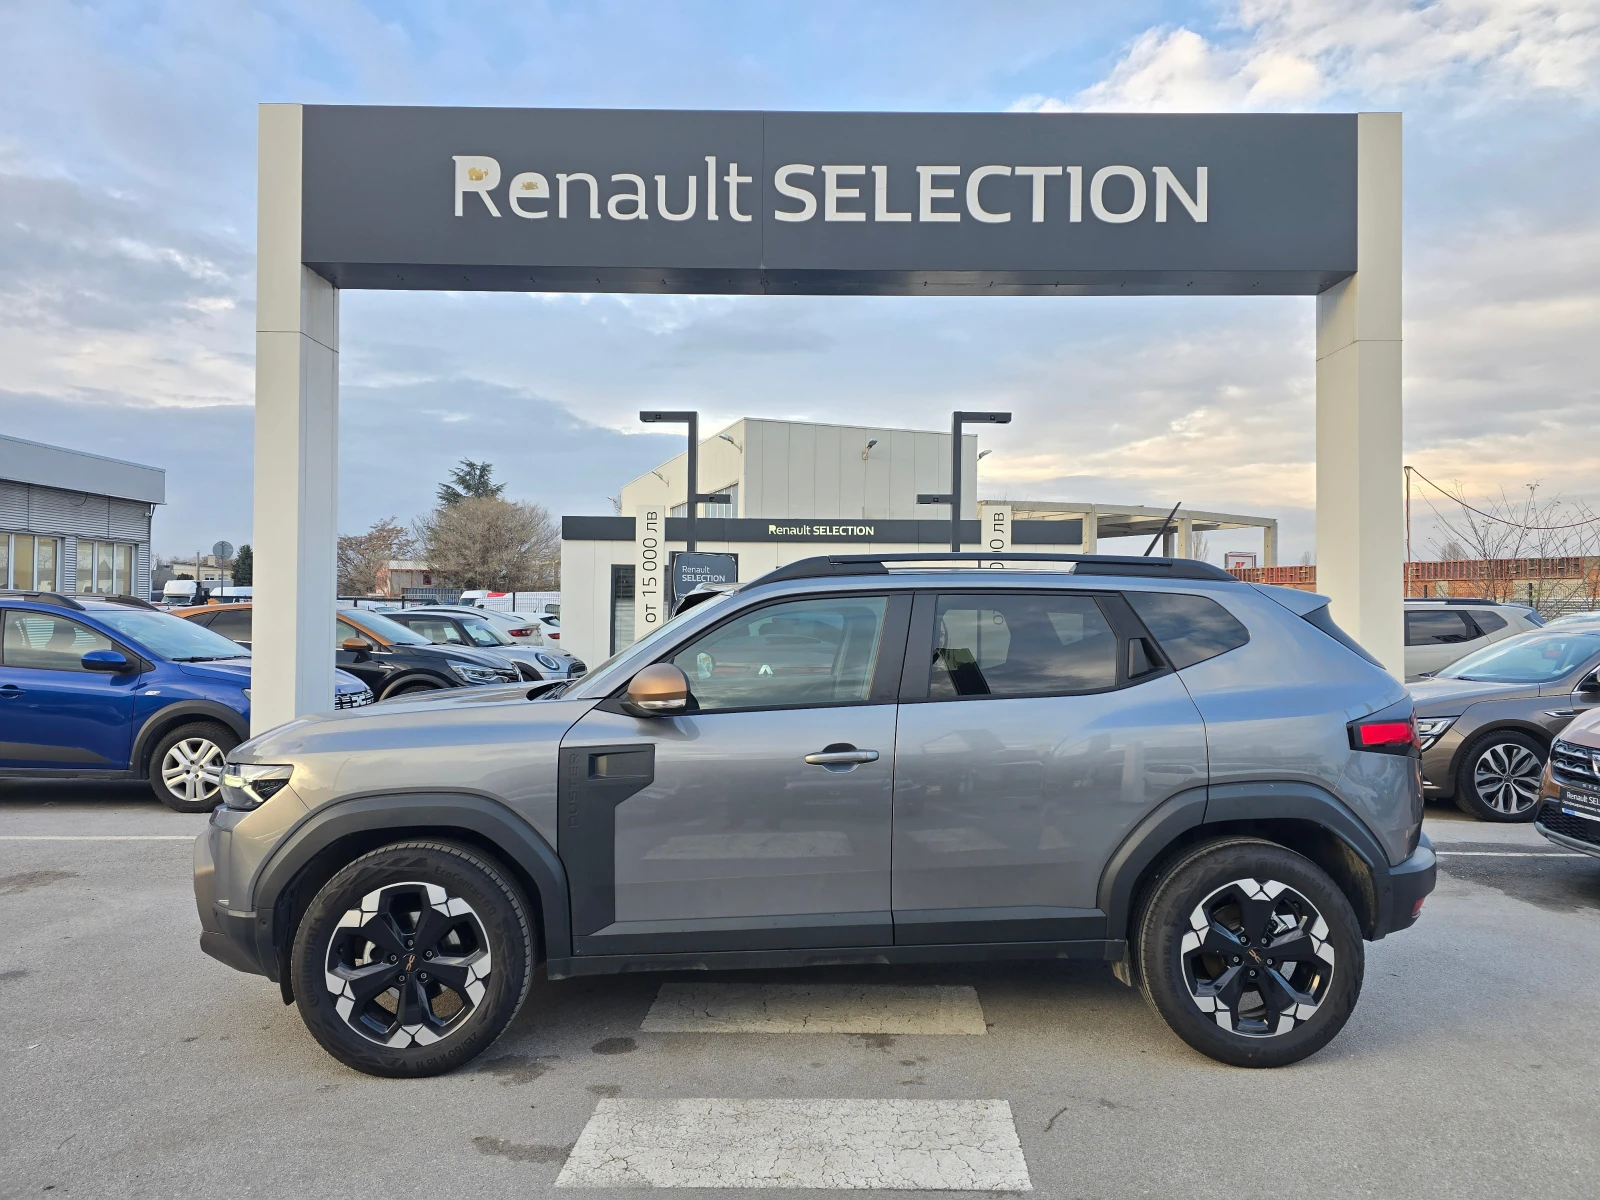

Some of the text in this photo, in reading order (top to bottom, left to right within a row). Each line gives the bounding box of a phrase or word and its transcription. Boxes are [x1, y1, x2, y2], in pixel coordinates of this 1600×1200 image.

[452, 156, 1207, 223] Renault SELECTION
[768, 524, 874, 536] Renault SELECTION
[642, 537, 658, 572] 000
[682, 566, 711, 574] Renault
[682, 574, 726, 583] SELECTION
[642, 577, 657, 597] 15
[568, 753, 580, 828] DUSTER
[1566, 791, 1588, 803] Renault
[1588, 796, 1600, 806] SEL
